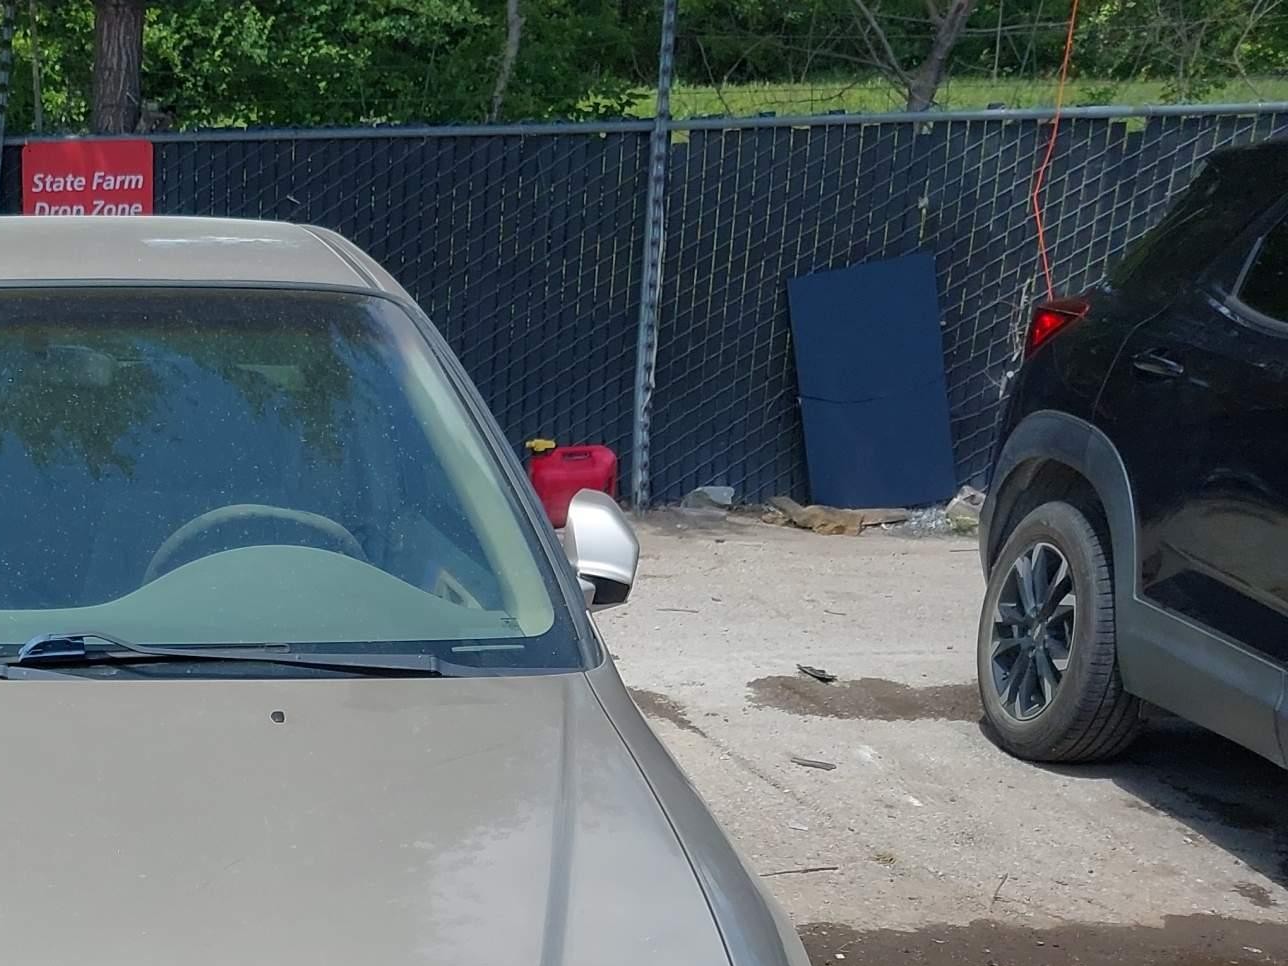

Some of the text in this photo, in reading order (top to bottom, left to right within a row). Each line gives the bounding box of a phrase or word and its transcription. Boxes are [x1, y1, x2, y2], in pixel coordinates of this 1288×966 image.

[32, 171, 143, 192] State Farm
[92, 200, 143, 216] Zone
